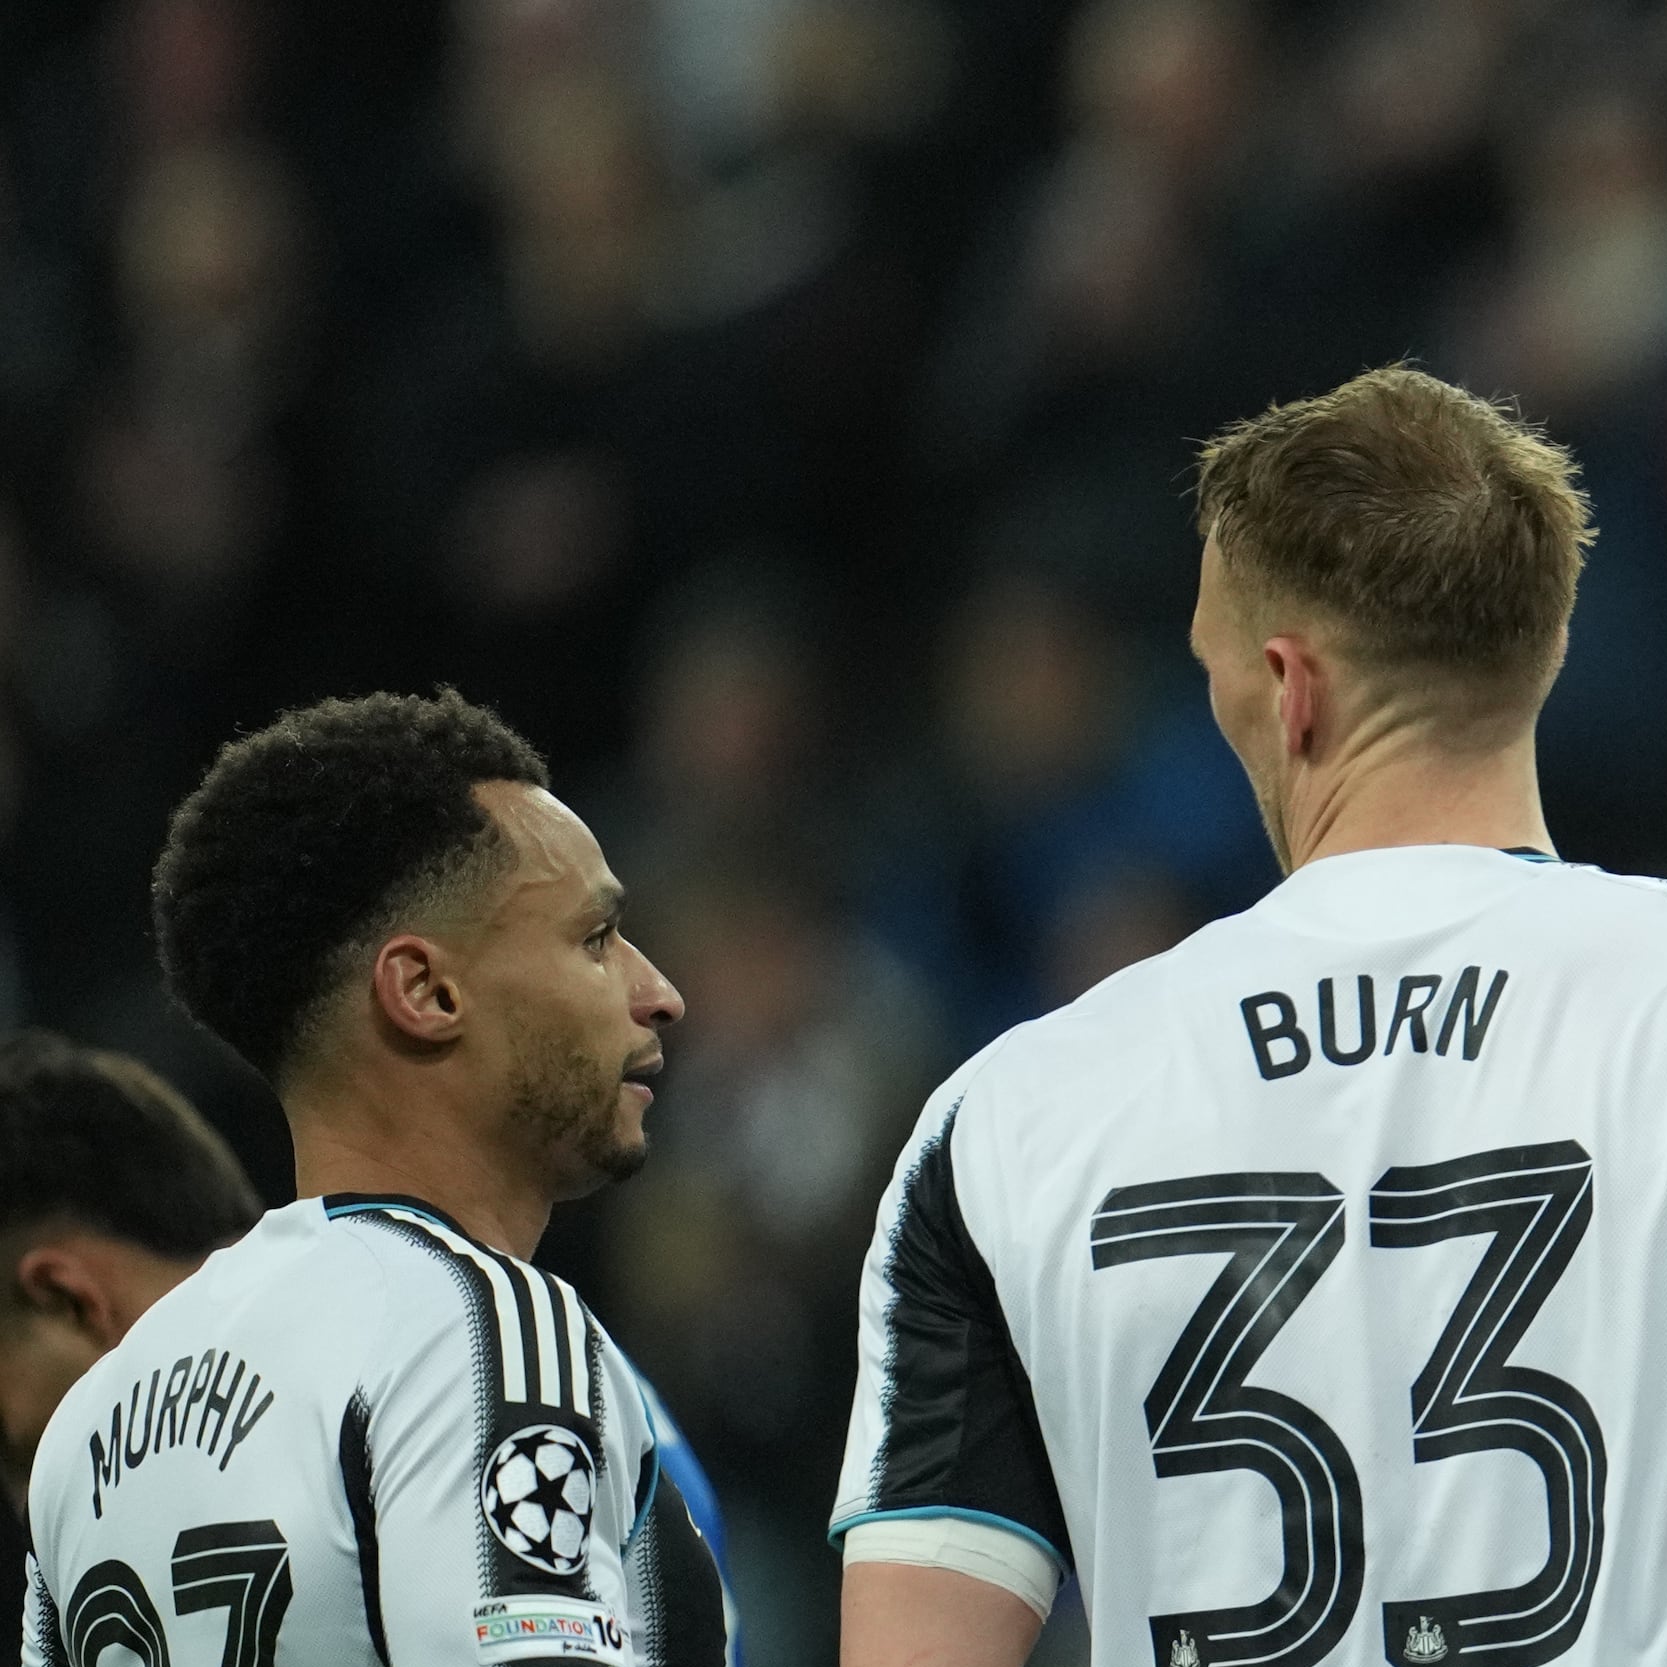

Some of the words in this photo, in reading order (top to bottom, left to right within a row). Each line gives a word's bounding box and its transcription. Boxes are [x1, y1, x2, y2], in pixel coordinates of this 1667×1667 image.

[1241, 965, 1510, 1081] BURN
[90, 1348, 275, 1520] MURPHY
[473, 1603, 508, 1618] UEFA
[476, 1619, 594, 1642] FOUNDATION
